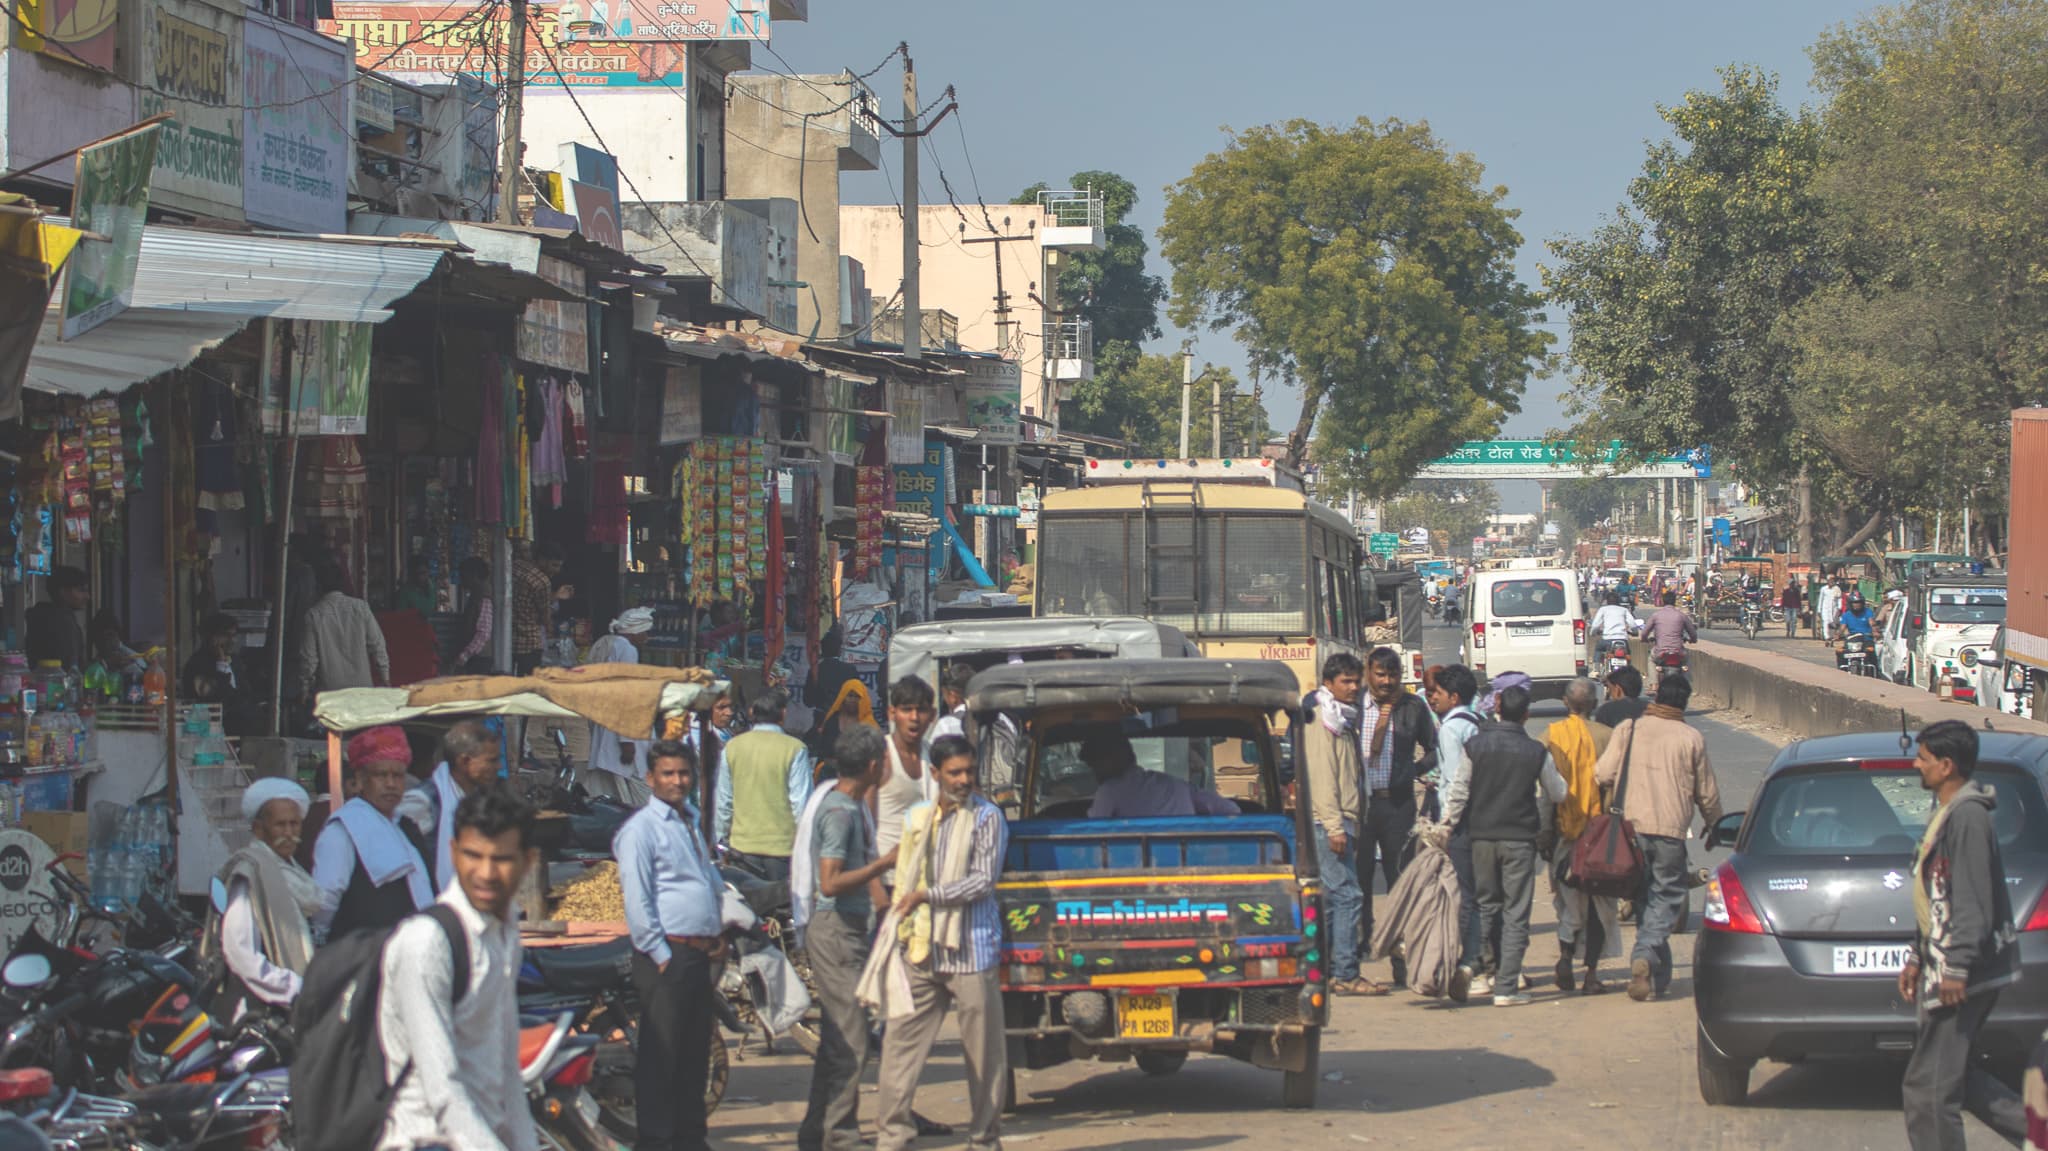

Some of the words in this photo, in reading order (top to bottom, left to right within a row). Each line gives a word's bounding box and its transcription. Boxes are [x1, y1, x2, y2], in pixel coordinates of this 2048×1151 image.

[1488, 445, 1514, 459] टोल
[1520, 445, 1542, 459] रोड
[1260, 642, 1312, 659] VIKRANT
[1056, 898, 1228, 925] Mahindra
[1245, 942, 1287, 958] TAXI
